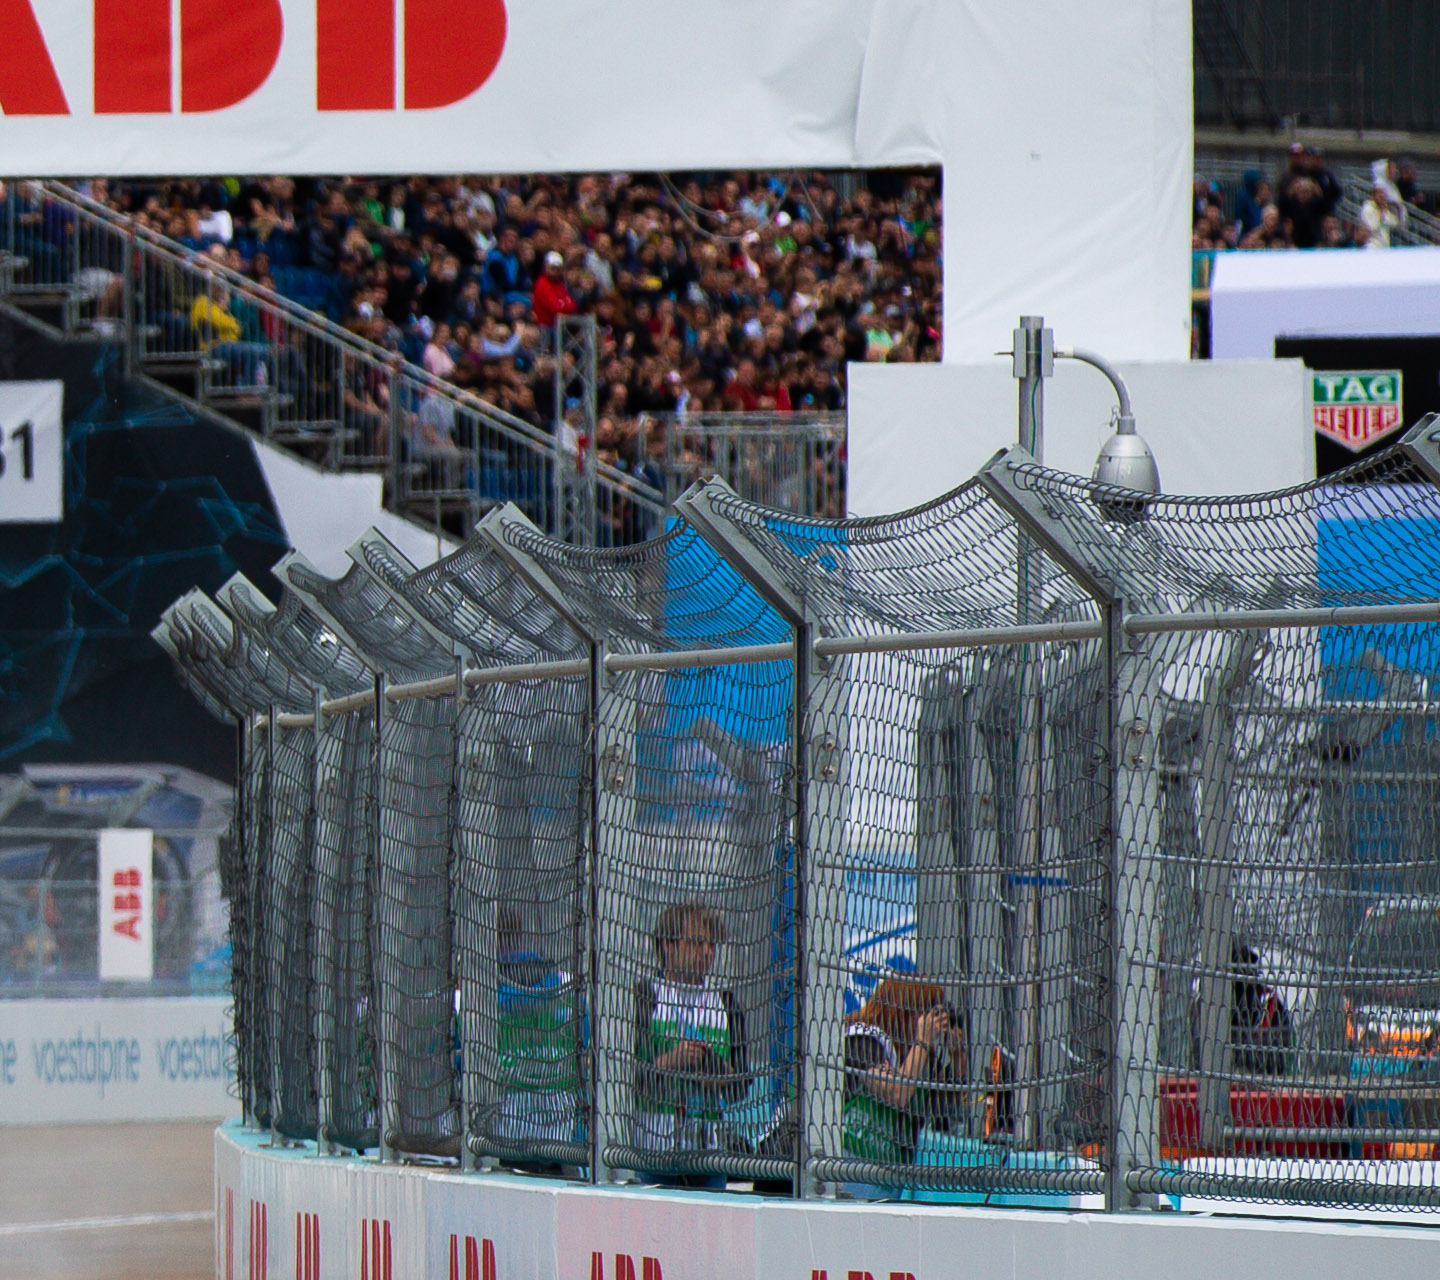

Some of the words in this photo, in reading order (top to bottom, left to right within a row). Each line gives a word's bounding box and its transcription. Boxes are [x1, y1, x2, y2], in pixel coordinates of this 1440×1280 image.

[1318, 376, 1393, 401] TAG
[1314, 406, 1398, 440] HEUER
[113, 868, 142, 941] ABB
[32, 1021, 141, 1099] voestalpine
